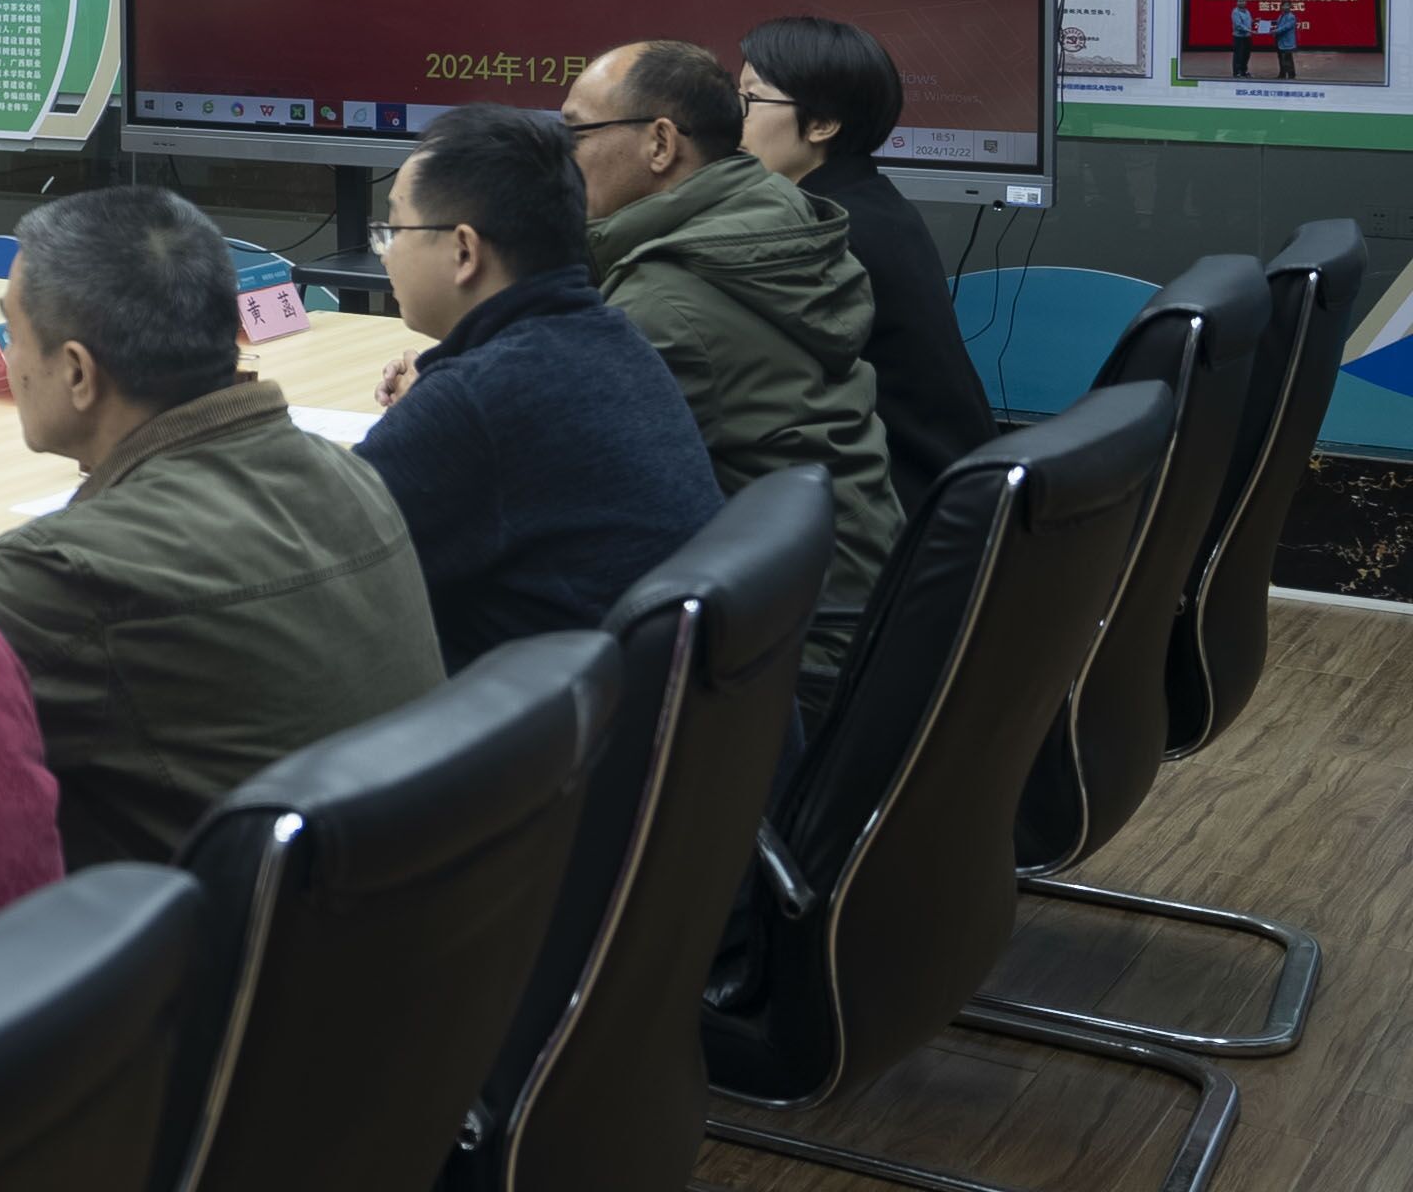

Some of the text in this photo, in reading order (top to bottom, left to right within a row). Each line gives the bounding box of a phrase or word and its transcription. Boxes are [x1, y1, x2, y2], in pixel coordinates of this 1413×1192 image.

[1259, 2, 1306, 12] 签订式
[930, 132, 956, 142] 18:51
[915, 146, 971, 157] 2024/12/22
